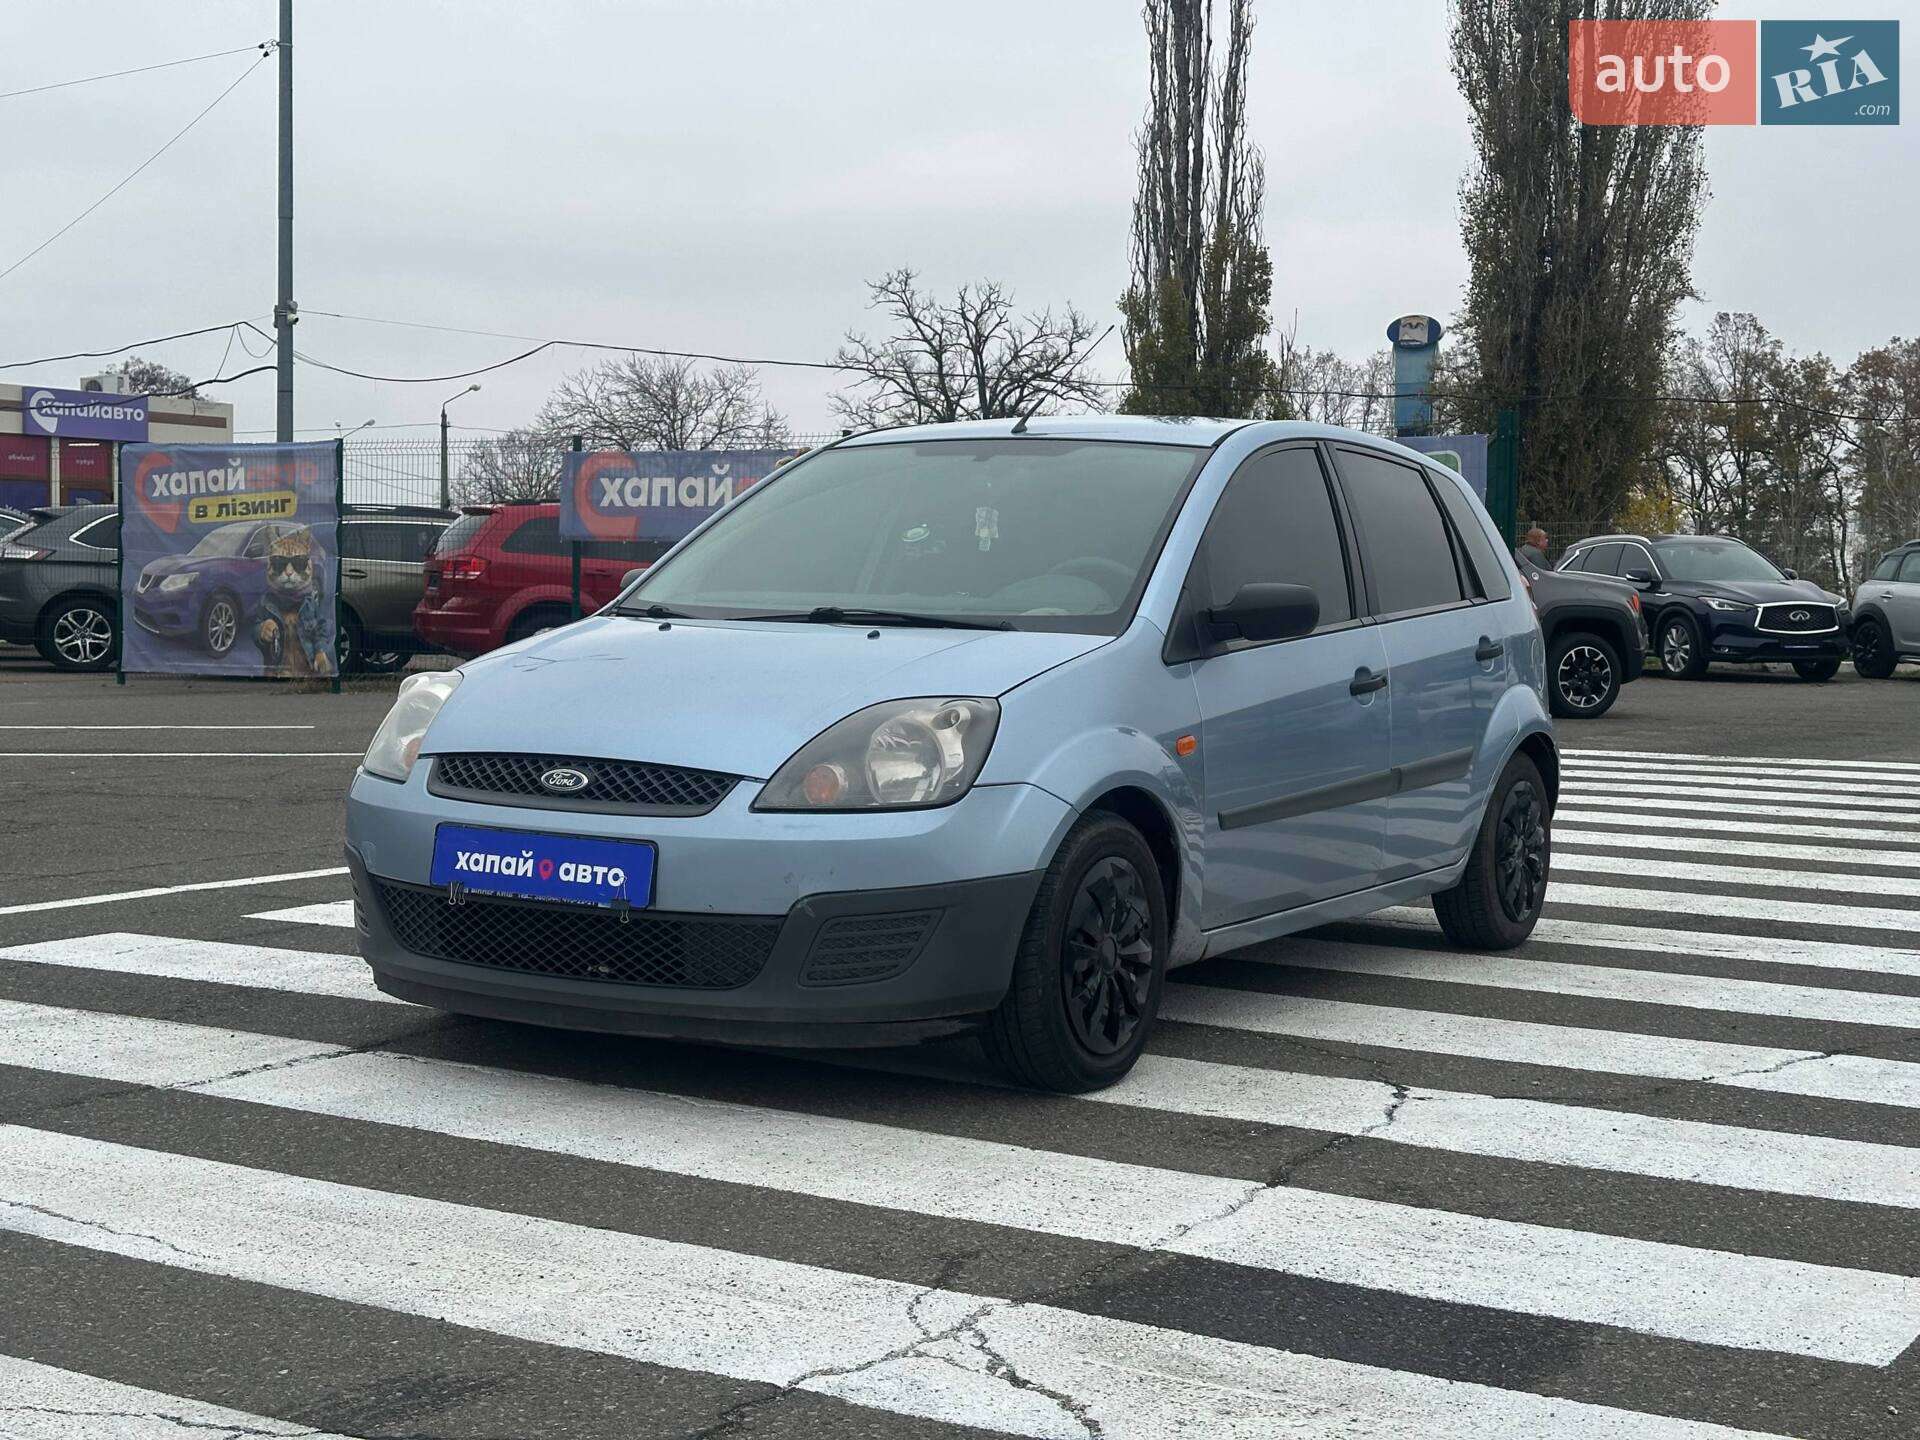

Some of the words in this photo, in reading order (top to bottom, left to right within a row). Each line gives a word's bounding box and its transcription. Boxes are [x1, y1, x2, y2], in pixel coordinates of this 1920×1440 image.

[216, 498, 291, 518] лізинг
[549, 771, 577, 786] Ford
[454, 849, 534, 878] хапай
[558, 862, 626, 888] авто
